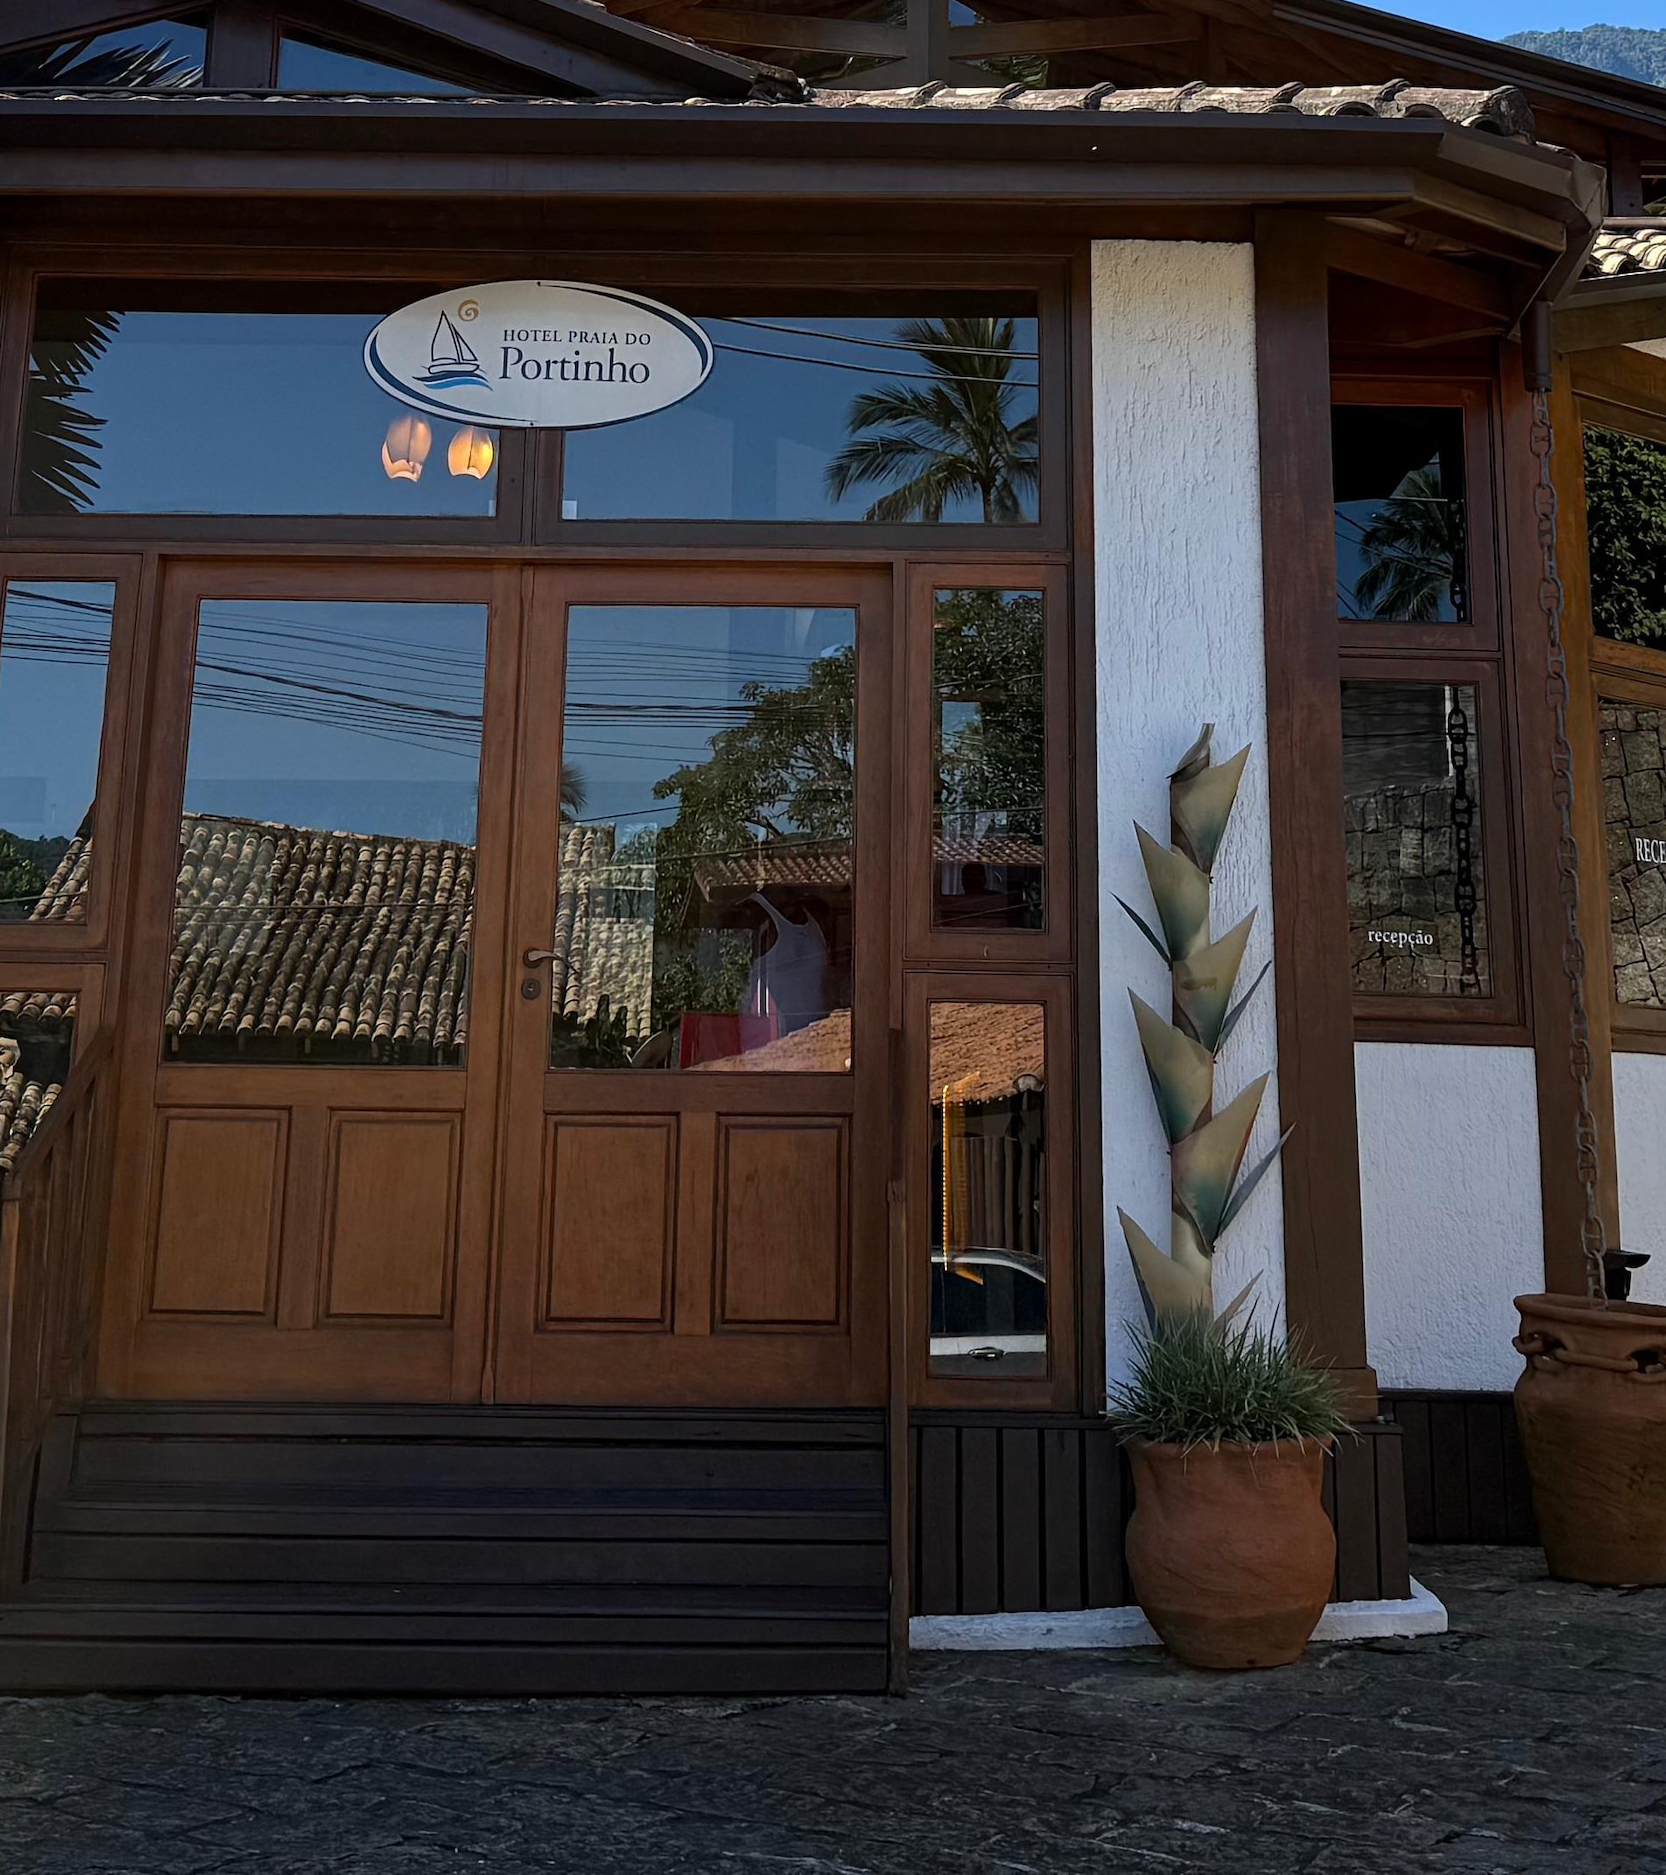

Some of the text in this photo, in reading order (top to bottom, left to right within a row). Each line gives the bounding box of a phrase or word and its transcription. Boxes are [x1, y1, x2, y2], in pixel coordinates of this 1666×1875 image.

[503, 329, 651, 346] HOTEL PRAIA DO
[499, 345, 650, 383] Portinho
[1367, 929, 1434, 950] recepção
